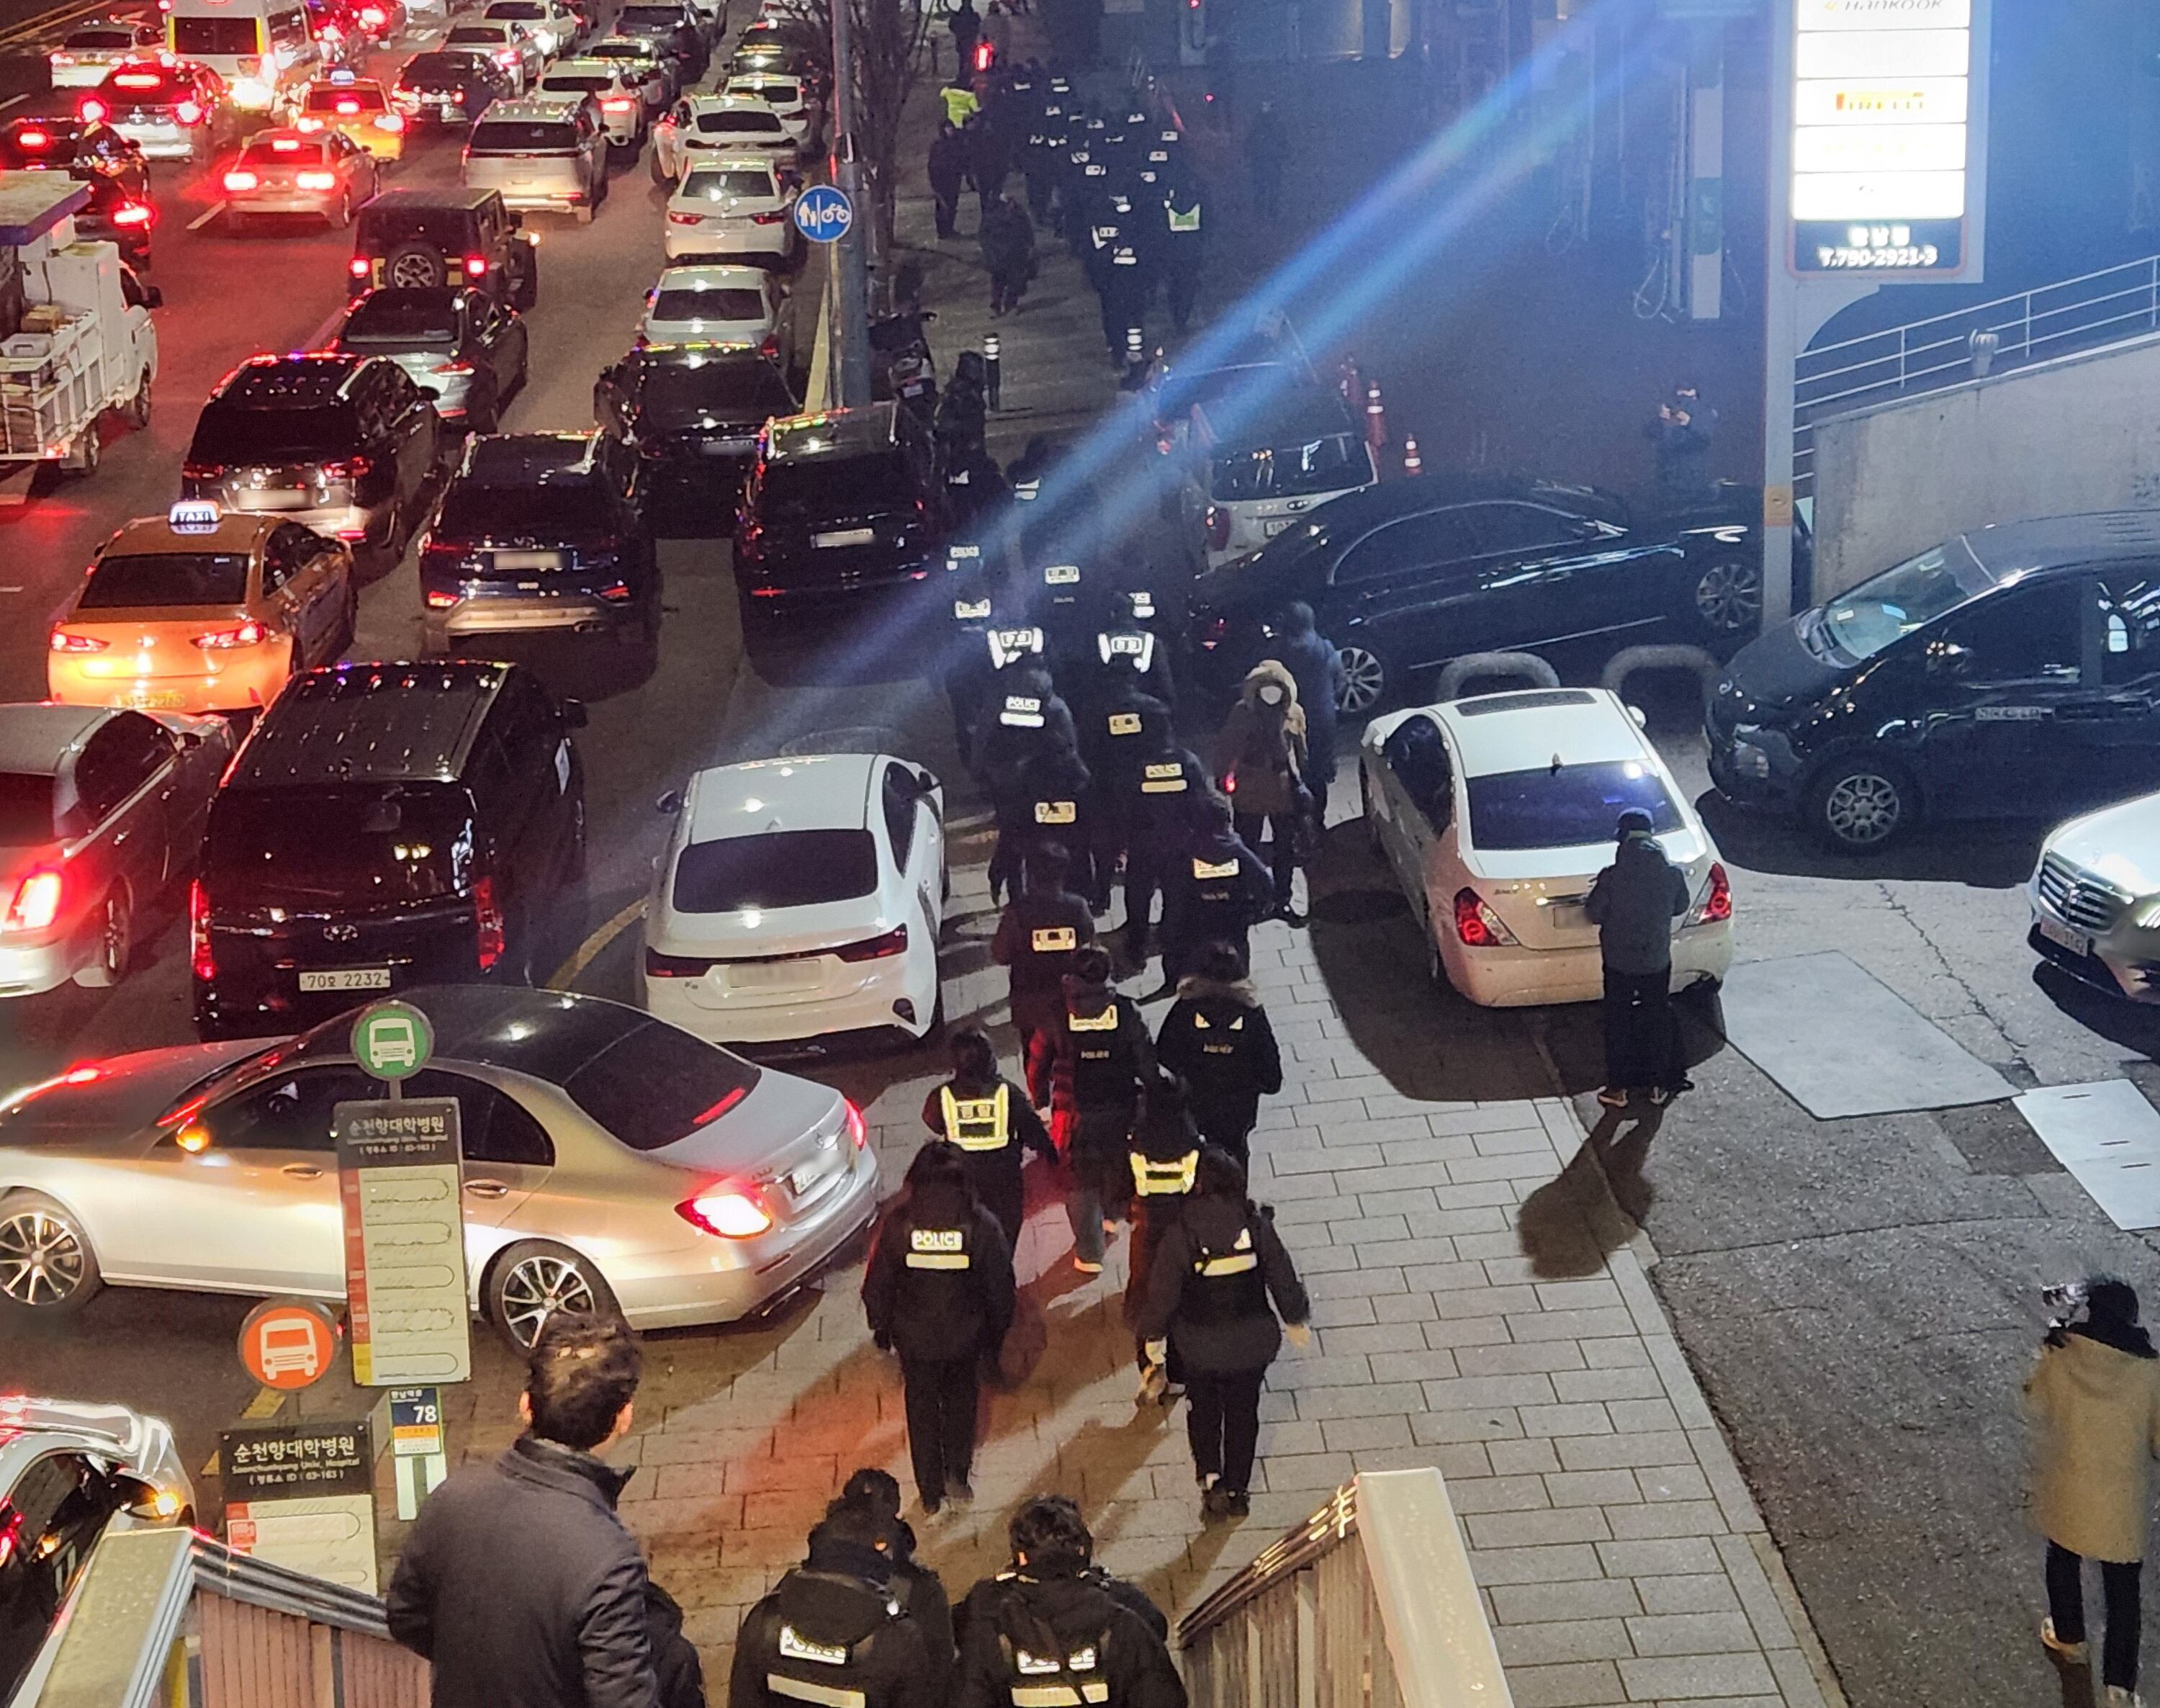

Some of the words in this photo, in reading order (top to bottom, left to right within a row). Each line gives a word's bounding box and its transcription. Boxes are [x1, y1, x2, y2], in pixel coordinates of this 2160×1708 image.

[178, 512, 210, 522] TAXI
[344, 972, 382, 986] 2232
[912, 1230, 962, 1247] POLICE
[413, 1405, 437, 1424] 78
[235, 1437, 354, 1462] 순천향대학병원
